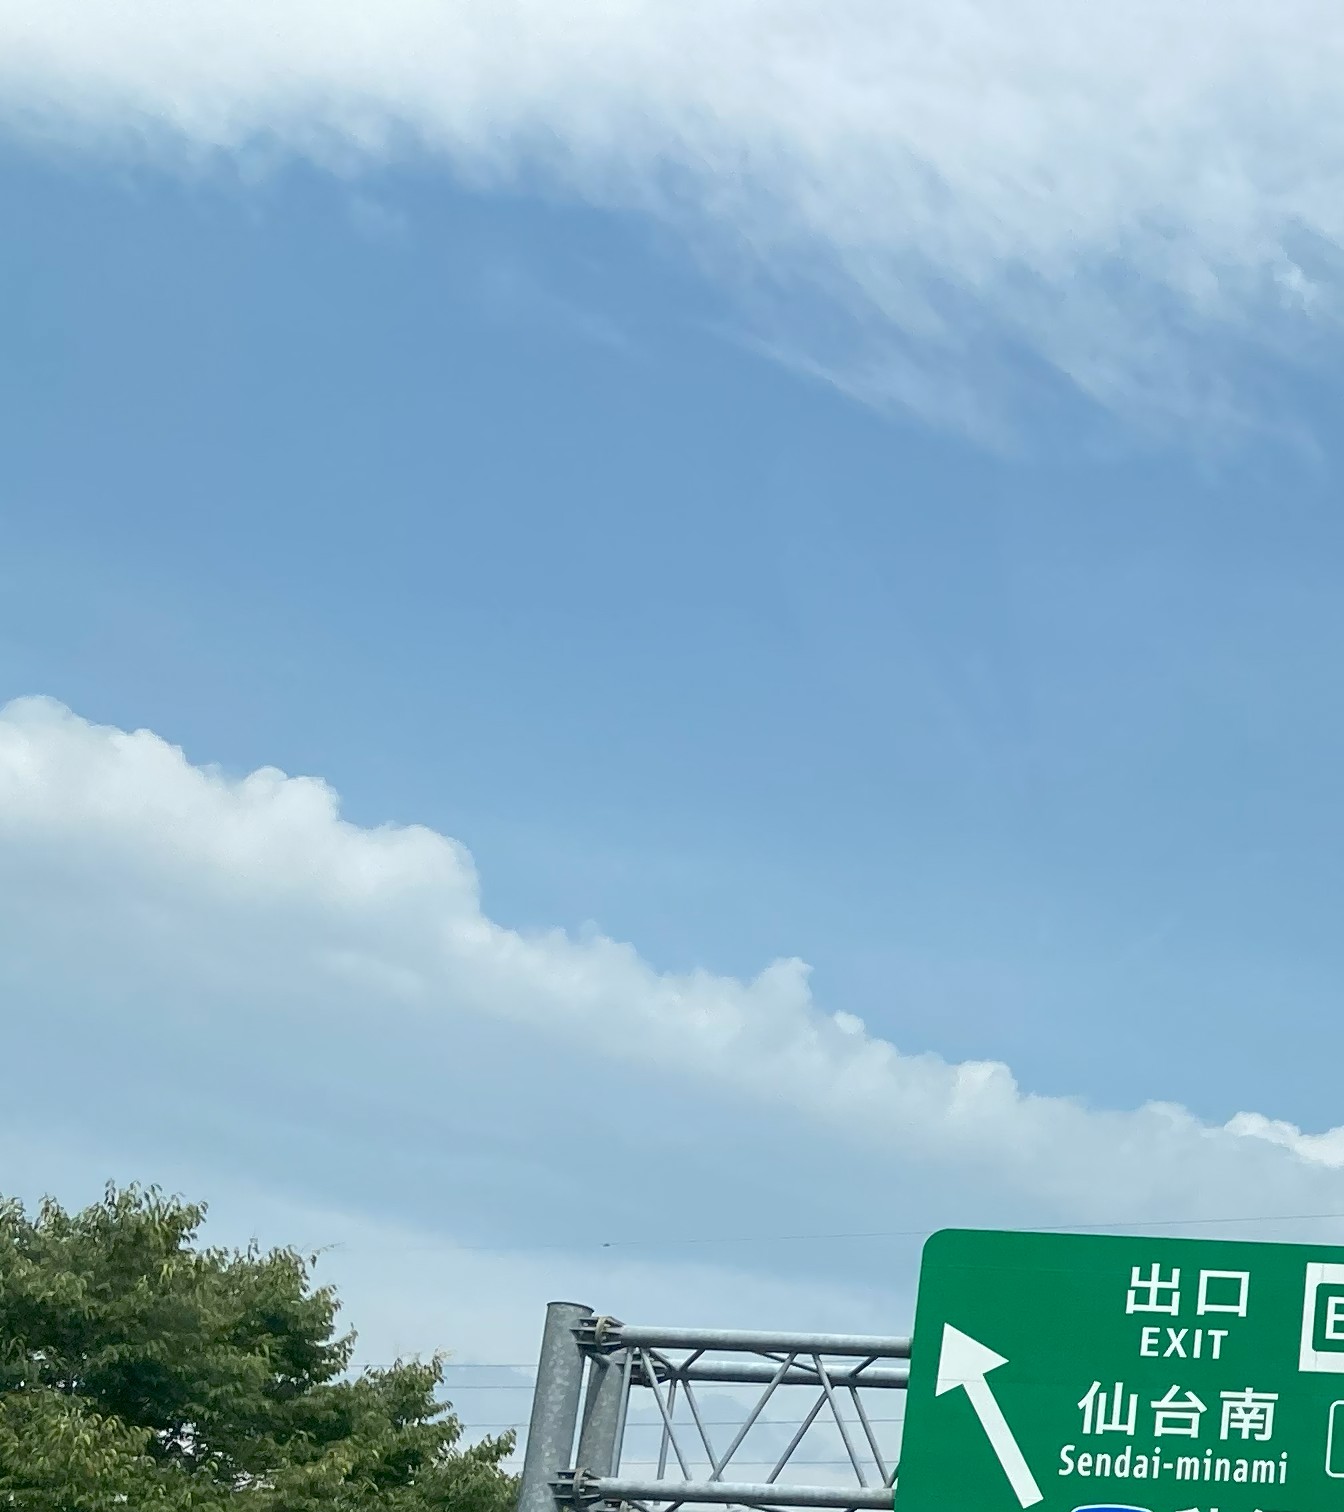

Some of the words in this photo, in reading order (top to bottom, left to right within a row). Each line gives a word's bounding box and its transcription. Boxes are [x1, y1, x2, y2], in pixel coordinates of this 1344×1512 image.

[1125, 1262, 1251, 1319] 出口
[1139, 1326, 1231, 1361] EXIT
[1077, 1380, 1279, 1442] 仙台南
[1058, 1444, 1289, 1487] Sendai-minami
